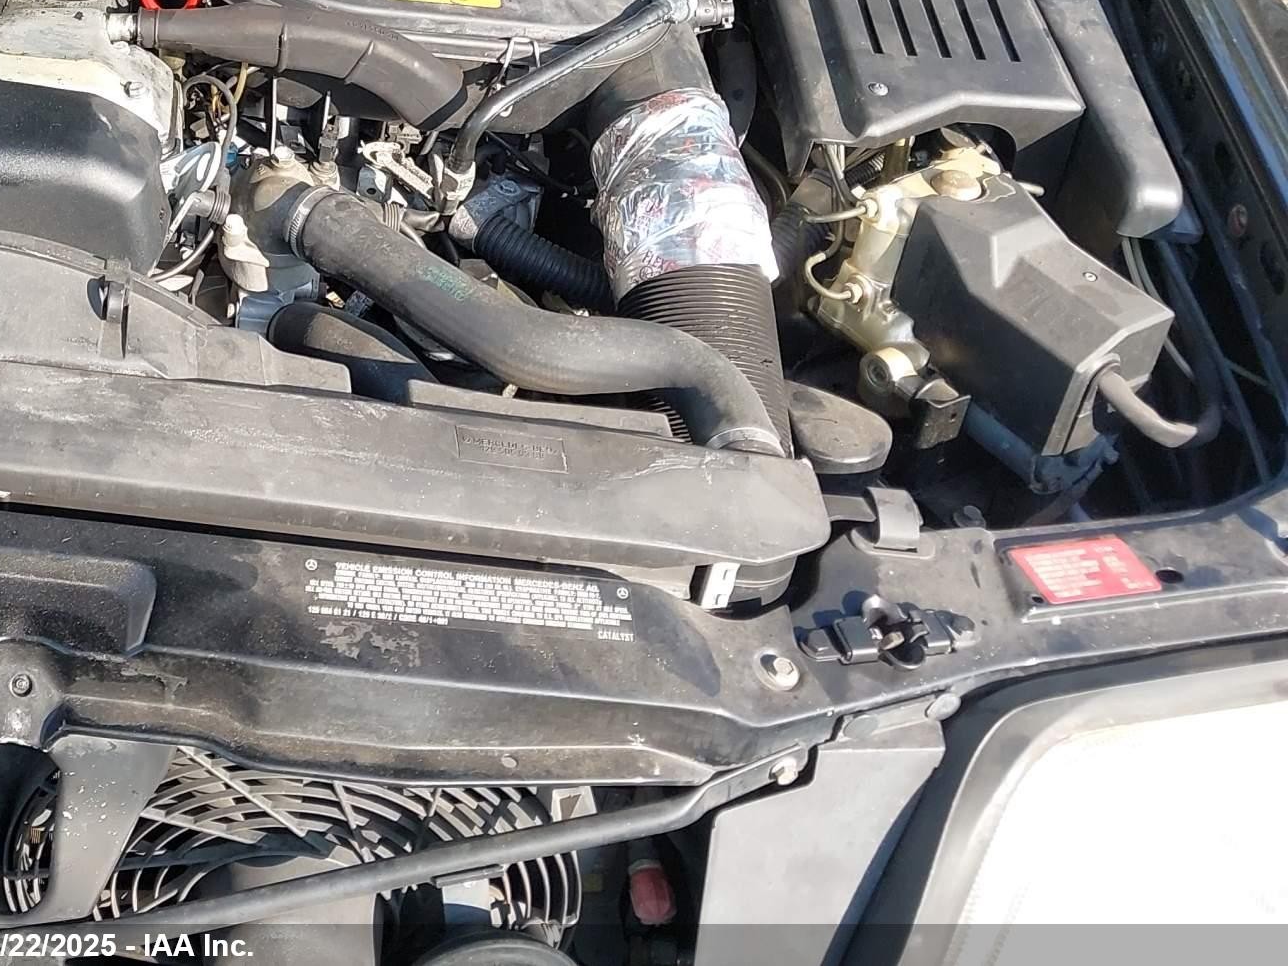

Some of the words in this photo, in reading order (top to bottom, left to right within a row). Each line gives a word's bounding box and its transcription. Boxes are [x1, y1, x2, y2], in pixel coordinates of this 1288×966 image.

[335, 562, 371, 573] VEHICLE
[415, 569, 454, 580] CONTROL
[456, 571, 512, 585] INFORMATION
[598, 630, 635, 642] CATALYST
